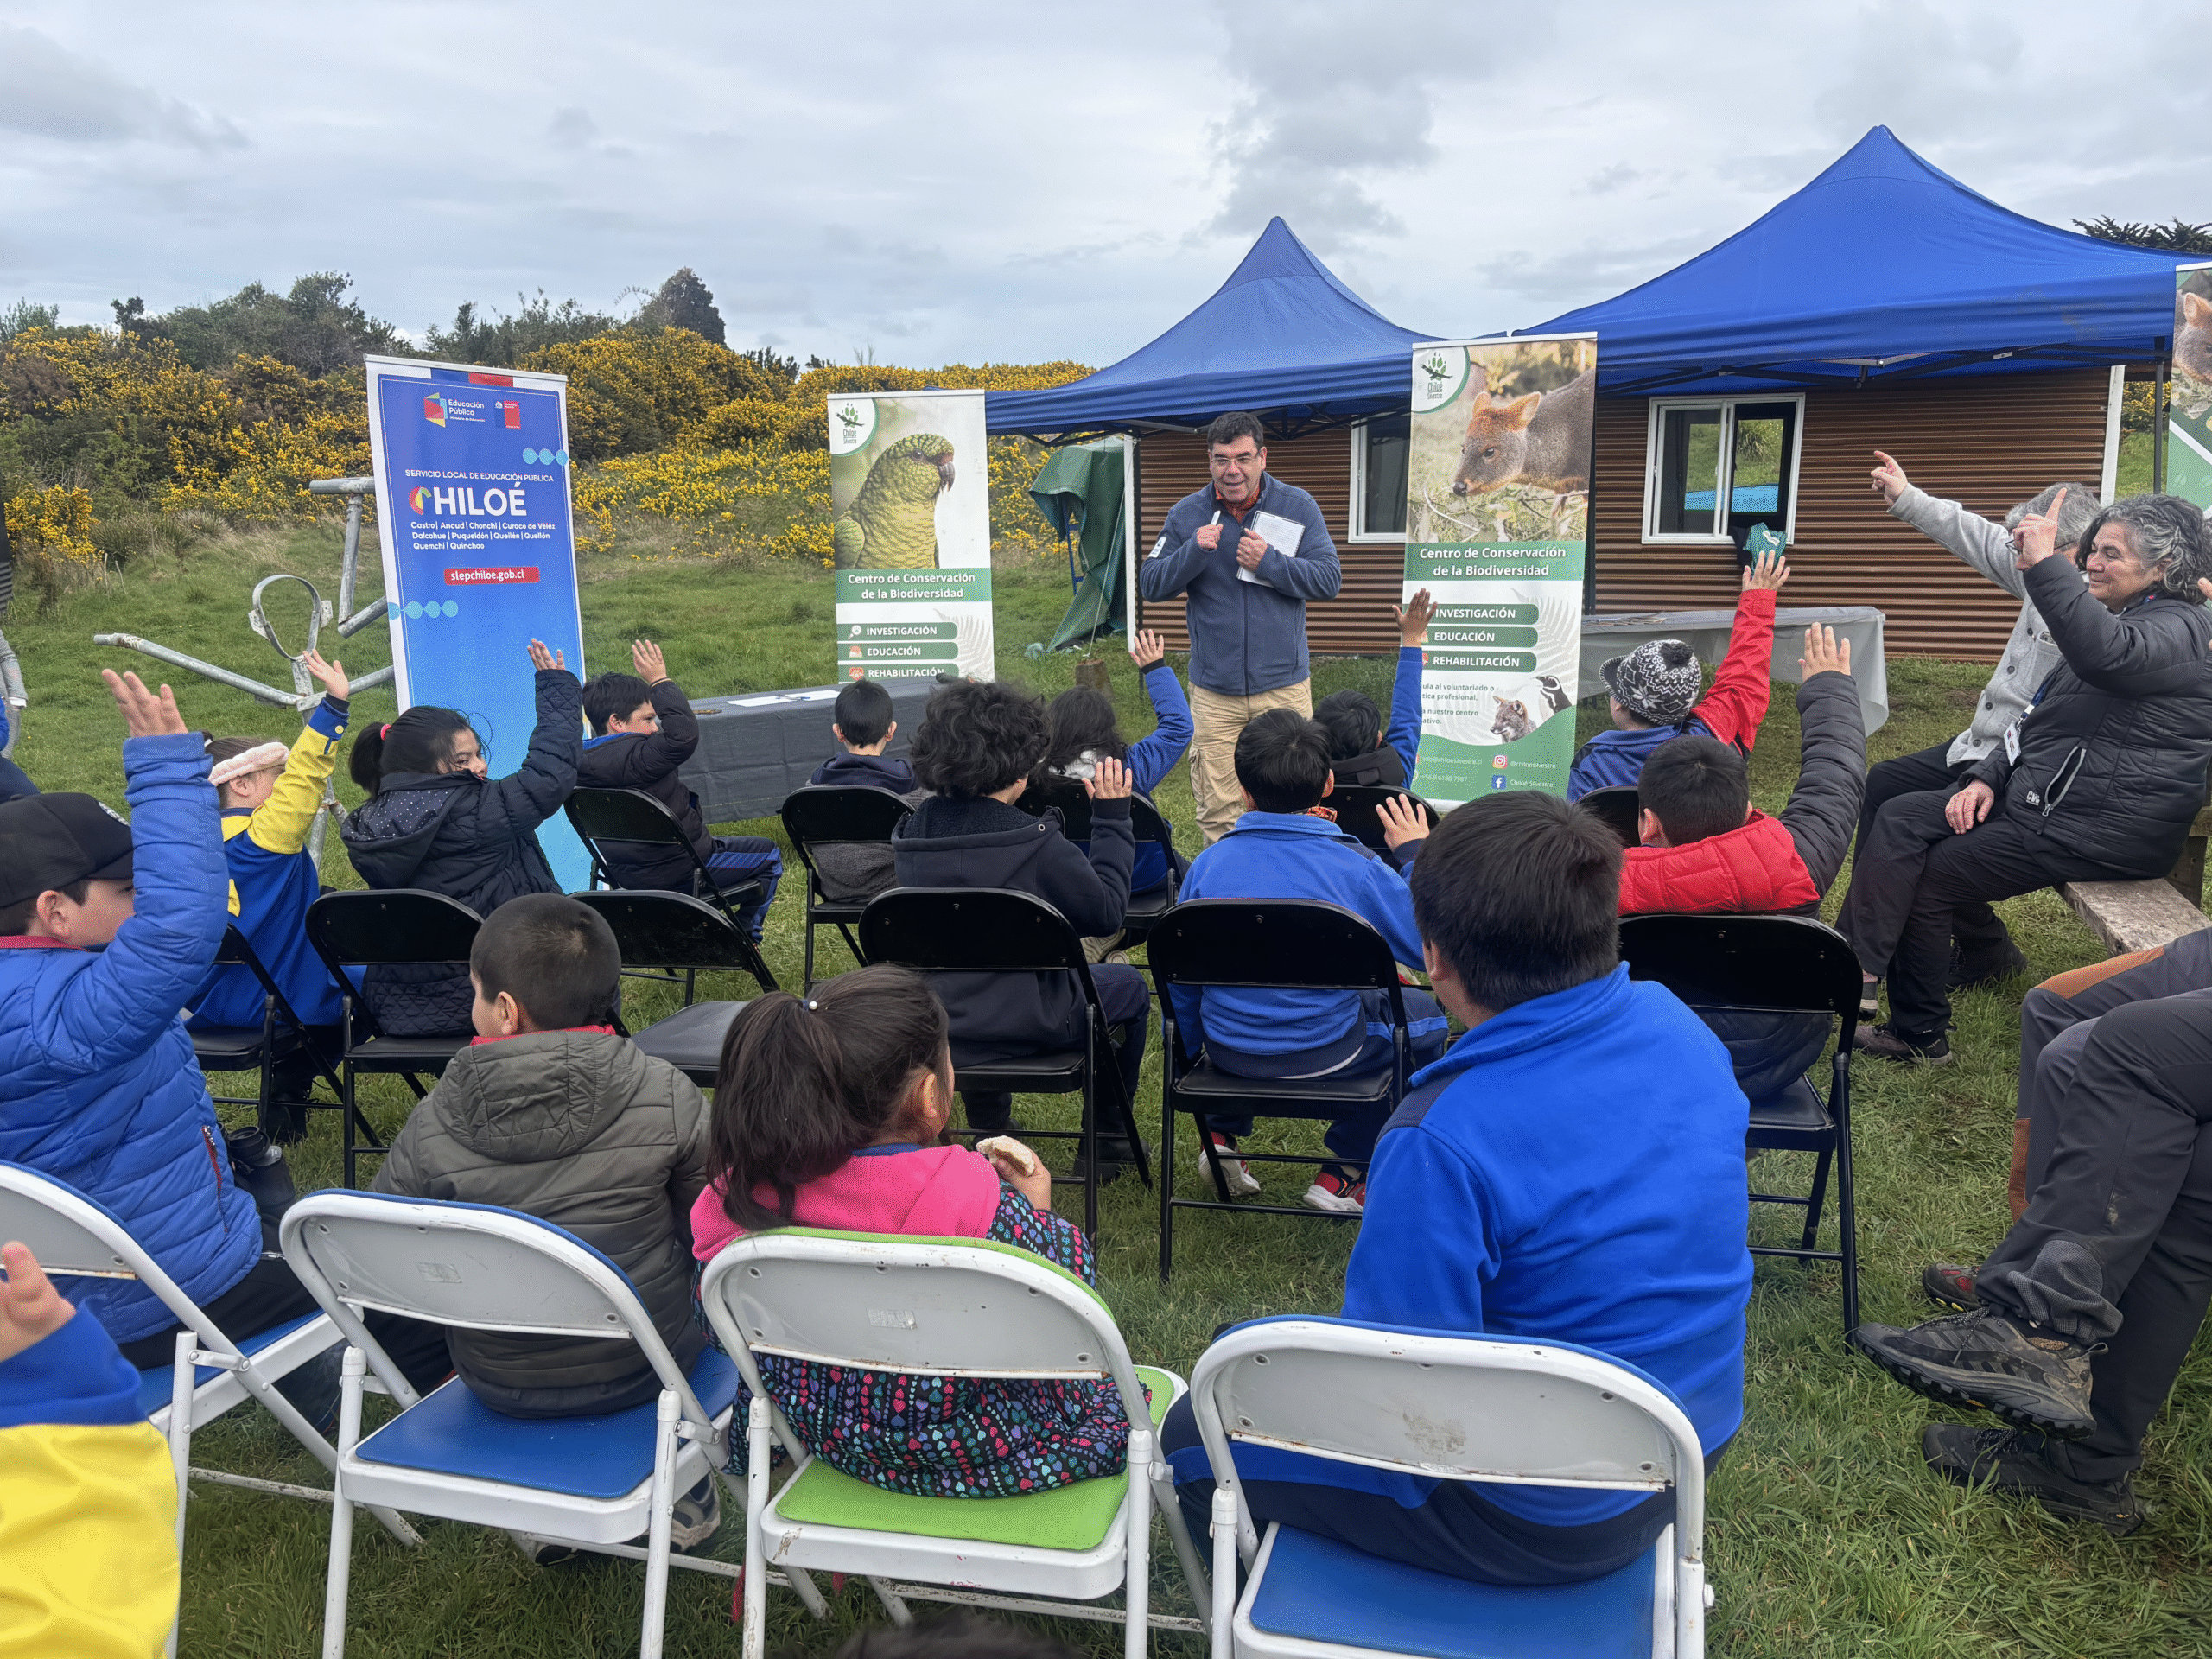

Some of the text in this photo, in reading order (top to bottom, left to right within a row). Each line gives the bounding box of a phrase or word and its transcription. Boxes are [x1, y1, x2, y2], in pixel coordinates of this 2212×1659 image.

[448, 398, 486, 410] Educación
[448, 408, 475, 416] Pública
[404, 468, 555, 482] SERVICIO LOCAL DE EDUCACIÓN PÚBLICA
[410, 521, 556, 531] Castro Ancud Chonchi Curaco de Vélez
[411, 531, 446, 540] Dalcahue
[451, 531, 488, 542] Puqueldón
[524, 531, 550, 540] Quellón
[413, 542, 485, 550] Quemchi Quinchao
[1420, 545, 1566, 559] Centro de Conservación
[450, 569, 524, 582] slepchiloe.gob.cl
[1433, 564, 1549, 576] de la Biodiversidad
[848, 572, 976, 584] Centro de Conservación
[861, 588, 963, 599] de la Biodiversidad
[1435, 607, 1516, 619] INVESTIGACIÓN
[867, 625, 938, 636] INVESTIGACIÓN
[1434, 630, 1495, 642] EDUCACIÓN
[868, 645, 921, 657] EDUCACIÓN
[1433, 655, 1520, 667] REHABILITACIÓN
[868, 666, 944, 677] REHABILITACIÓN
